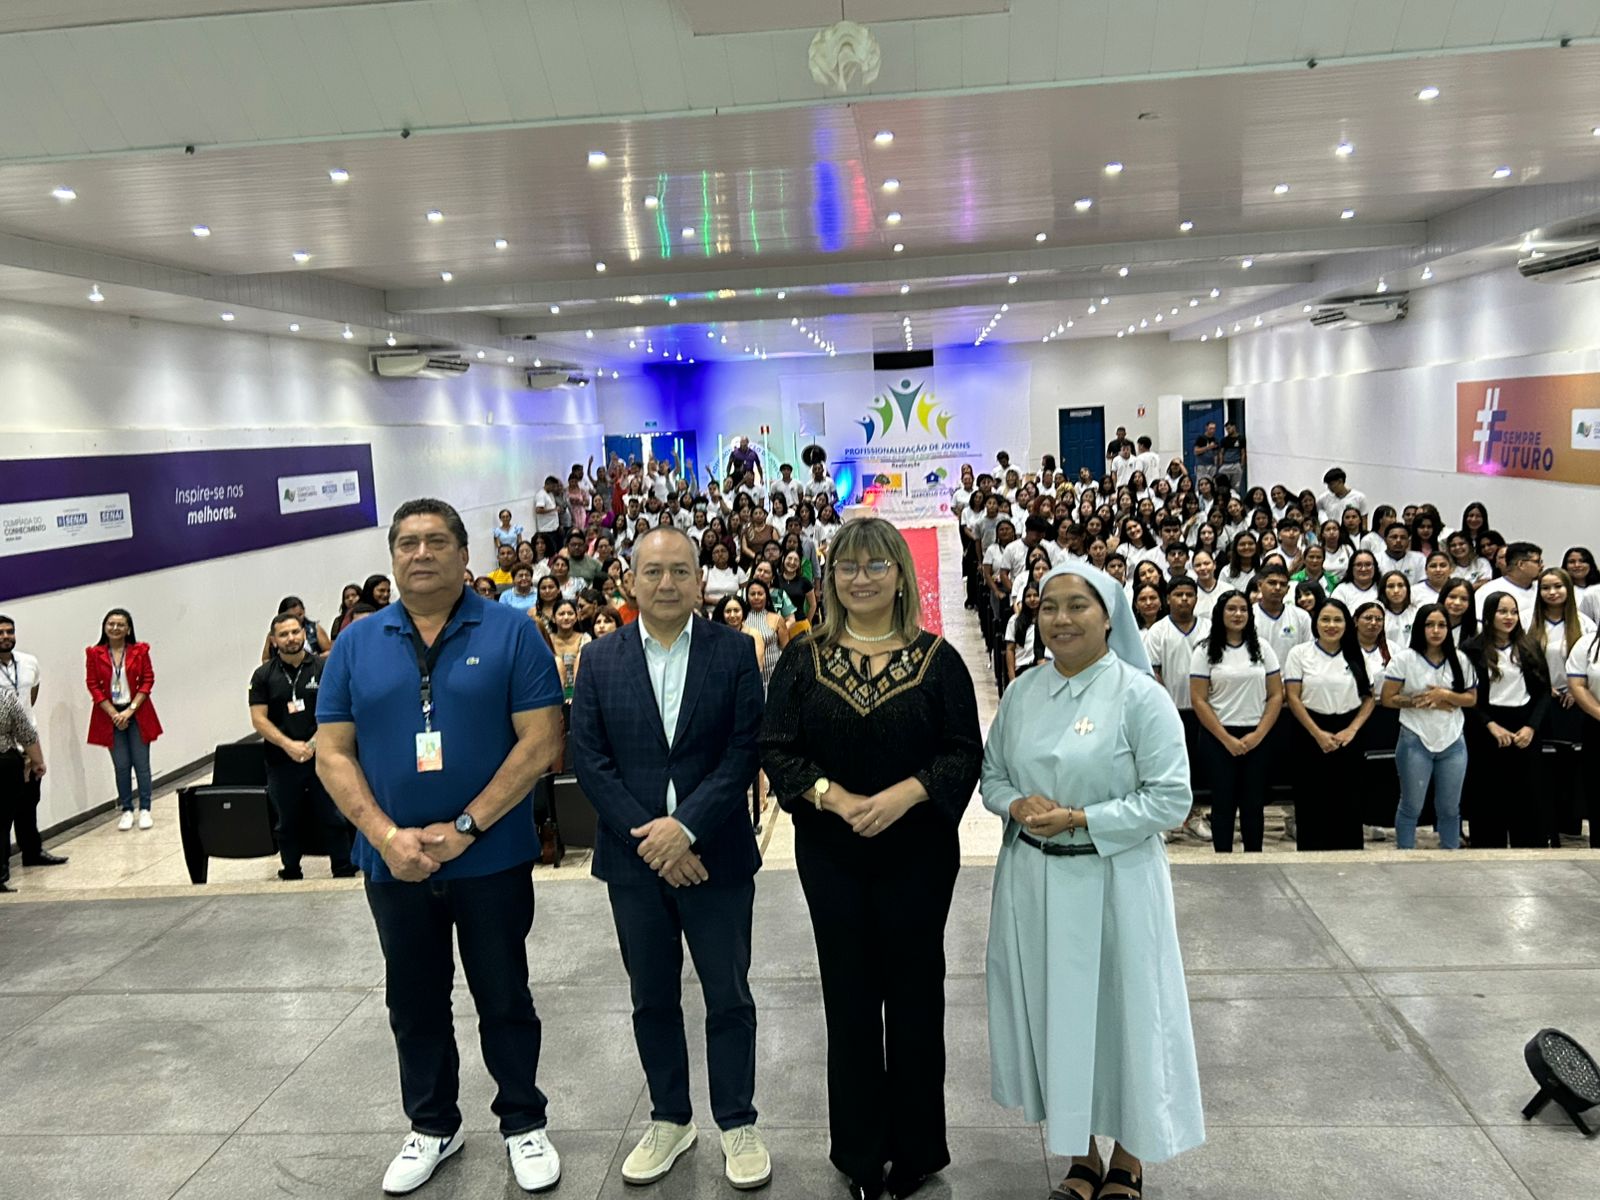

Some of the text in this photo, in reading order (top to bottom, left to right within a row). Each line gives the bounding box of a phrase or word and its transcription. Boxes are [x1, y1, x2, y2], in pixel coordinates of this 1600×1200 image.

[929, 443, 938, 451] DE
[941, 441, 970, 450] JOVENS
[1503, 431, 1541, 446] SEMPRE
[175, 484, 244, 506] Inspire-se nos
[187, 505, 237, 525] melhores.
[4, 525, 46, 536] CONHECIMENTO
